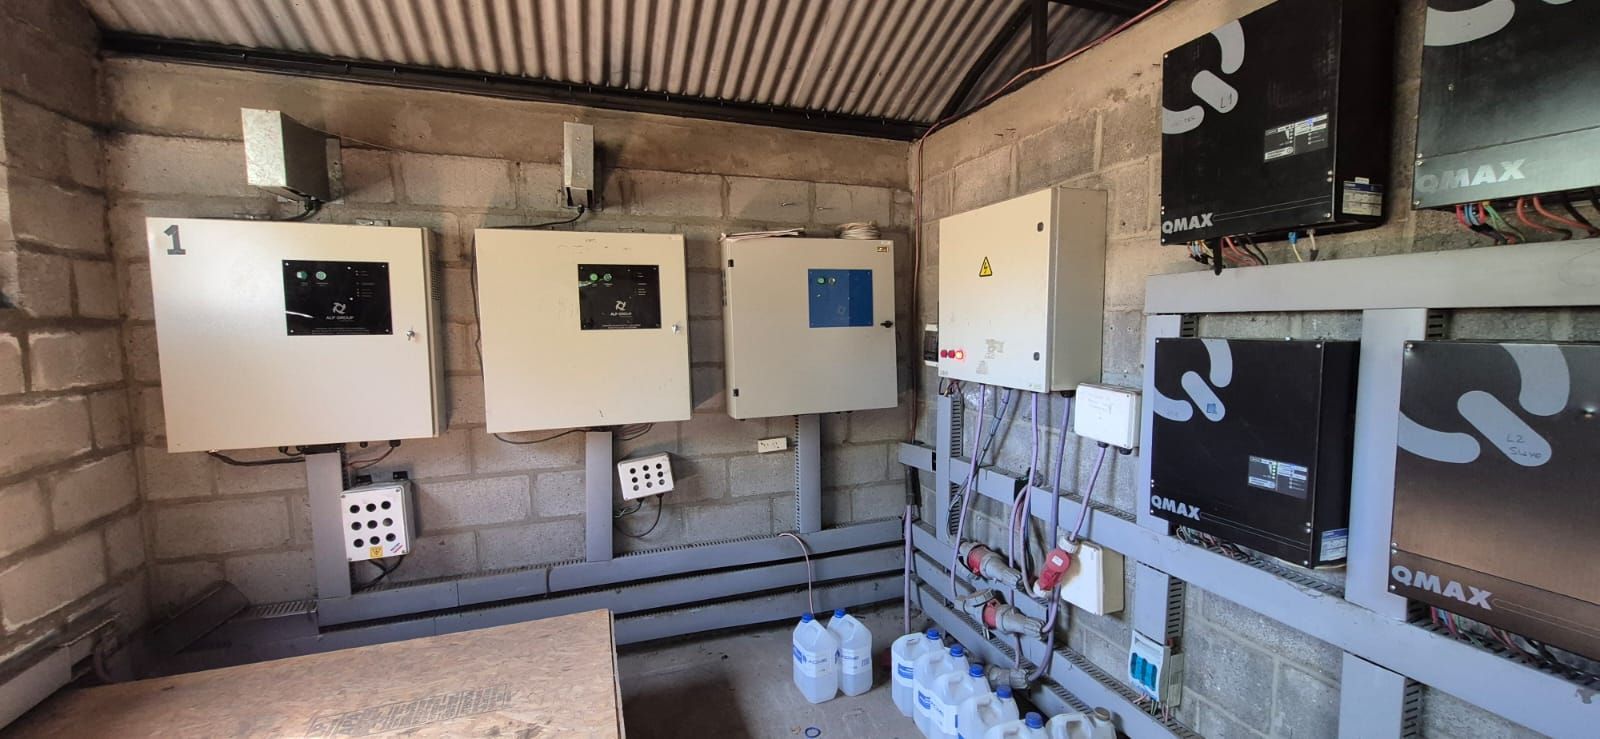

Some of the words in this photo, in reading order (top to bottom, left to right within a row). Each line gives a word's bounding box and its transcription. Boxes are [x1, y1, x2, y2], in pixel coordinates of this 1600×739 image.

[1413, 158, 1526, 193] QMAX
[1162, 212, 1213, 233] QMAX
[163, 224, 187, 256] 1
[1151, 495, 1200, 521] QMAX
[1391, 565, 1493, 610] QMAX
